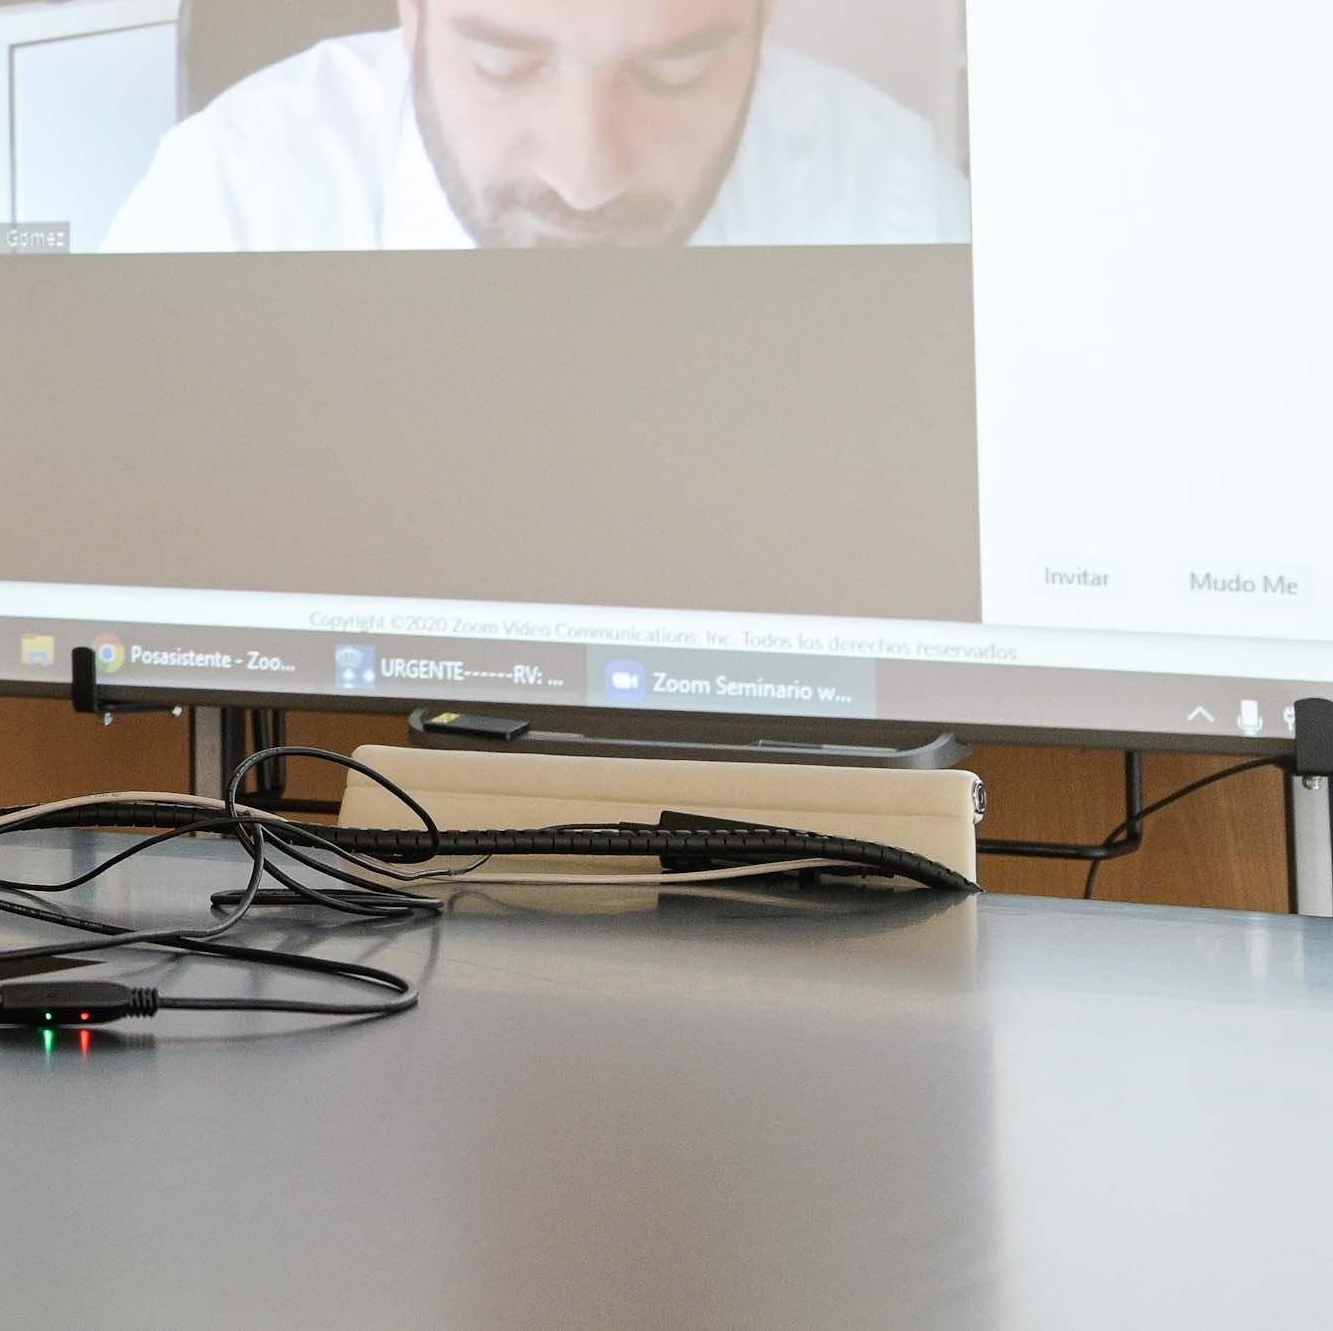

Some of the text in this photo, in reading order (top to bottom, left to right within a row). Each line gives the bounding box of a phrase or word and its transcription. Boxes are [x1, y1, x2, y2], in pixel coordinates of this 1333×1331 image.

[1045, 566, 1110, 588] Invitar
[1189, 571, 1299, 596] Mudo Me
[308, 610, 386, 633] Copyright
[452, 617, 499, 636] Zoom
[501, 618, 552, 637] Video
[741, 629, 793, 648] Todos
[797, 630, 822, 651] los
[828, 632, 909, 654] derechos
[131, 643, 232, 670] Posasistente
[651, 671, 711, 695] Zoom
[715, 674, 814, 703] Seminario
